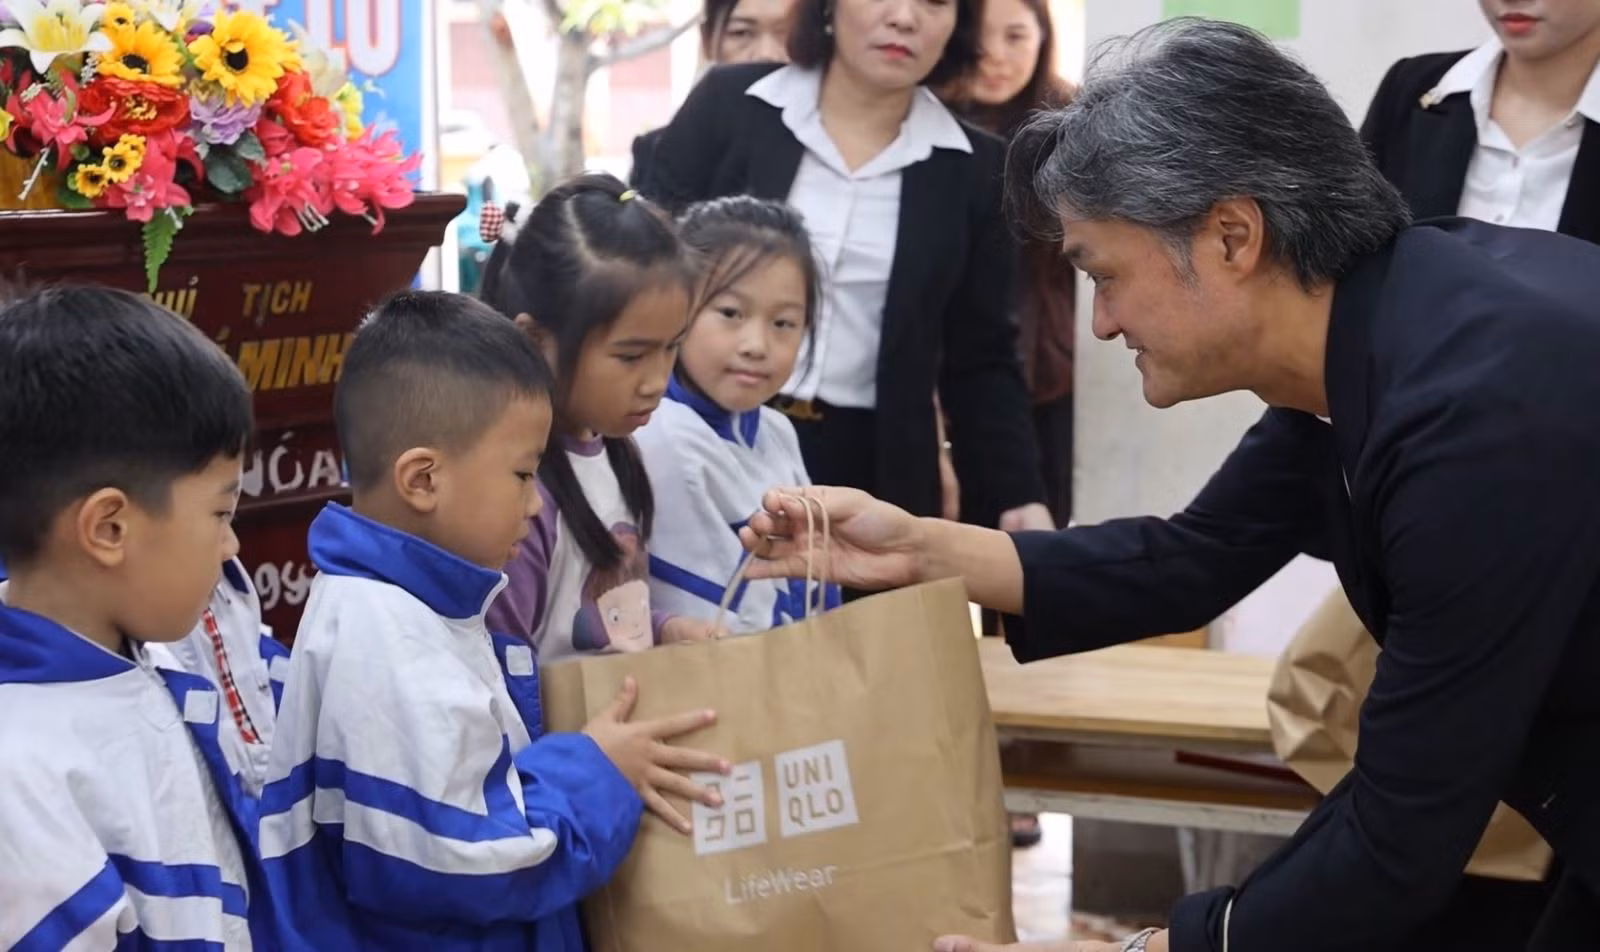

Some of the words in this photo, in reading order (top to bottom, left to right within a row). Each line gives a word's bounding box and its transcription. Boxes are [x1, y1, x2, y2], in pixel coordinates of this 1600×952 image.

[242, 280, 312, 326] TỊCH
[239, 332, 355, 390] MINH
[784, 753, 833, 789] UNI
[788, 788, 844, 827] QLO
[725, 864, 838, 904] LifeWear
